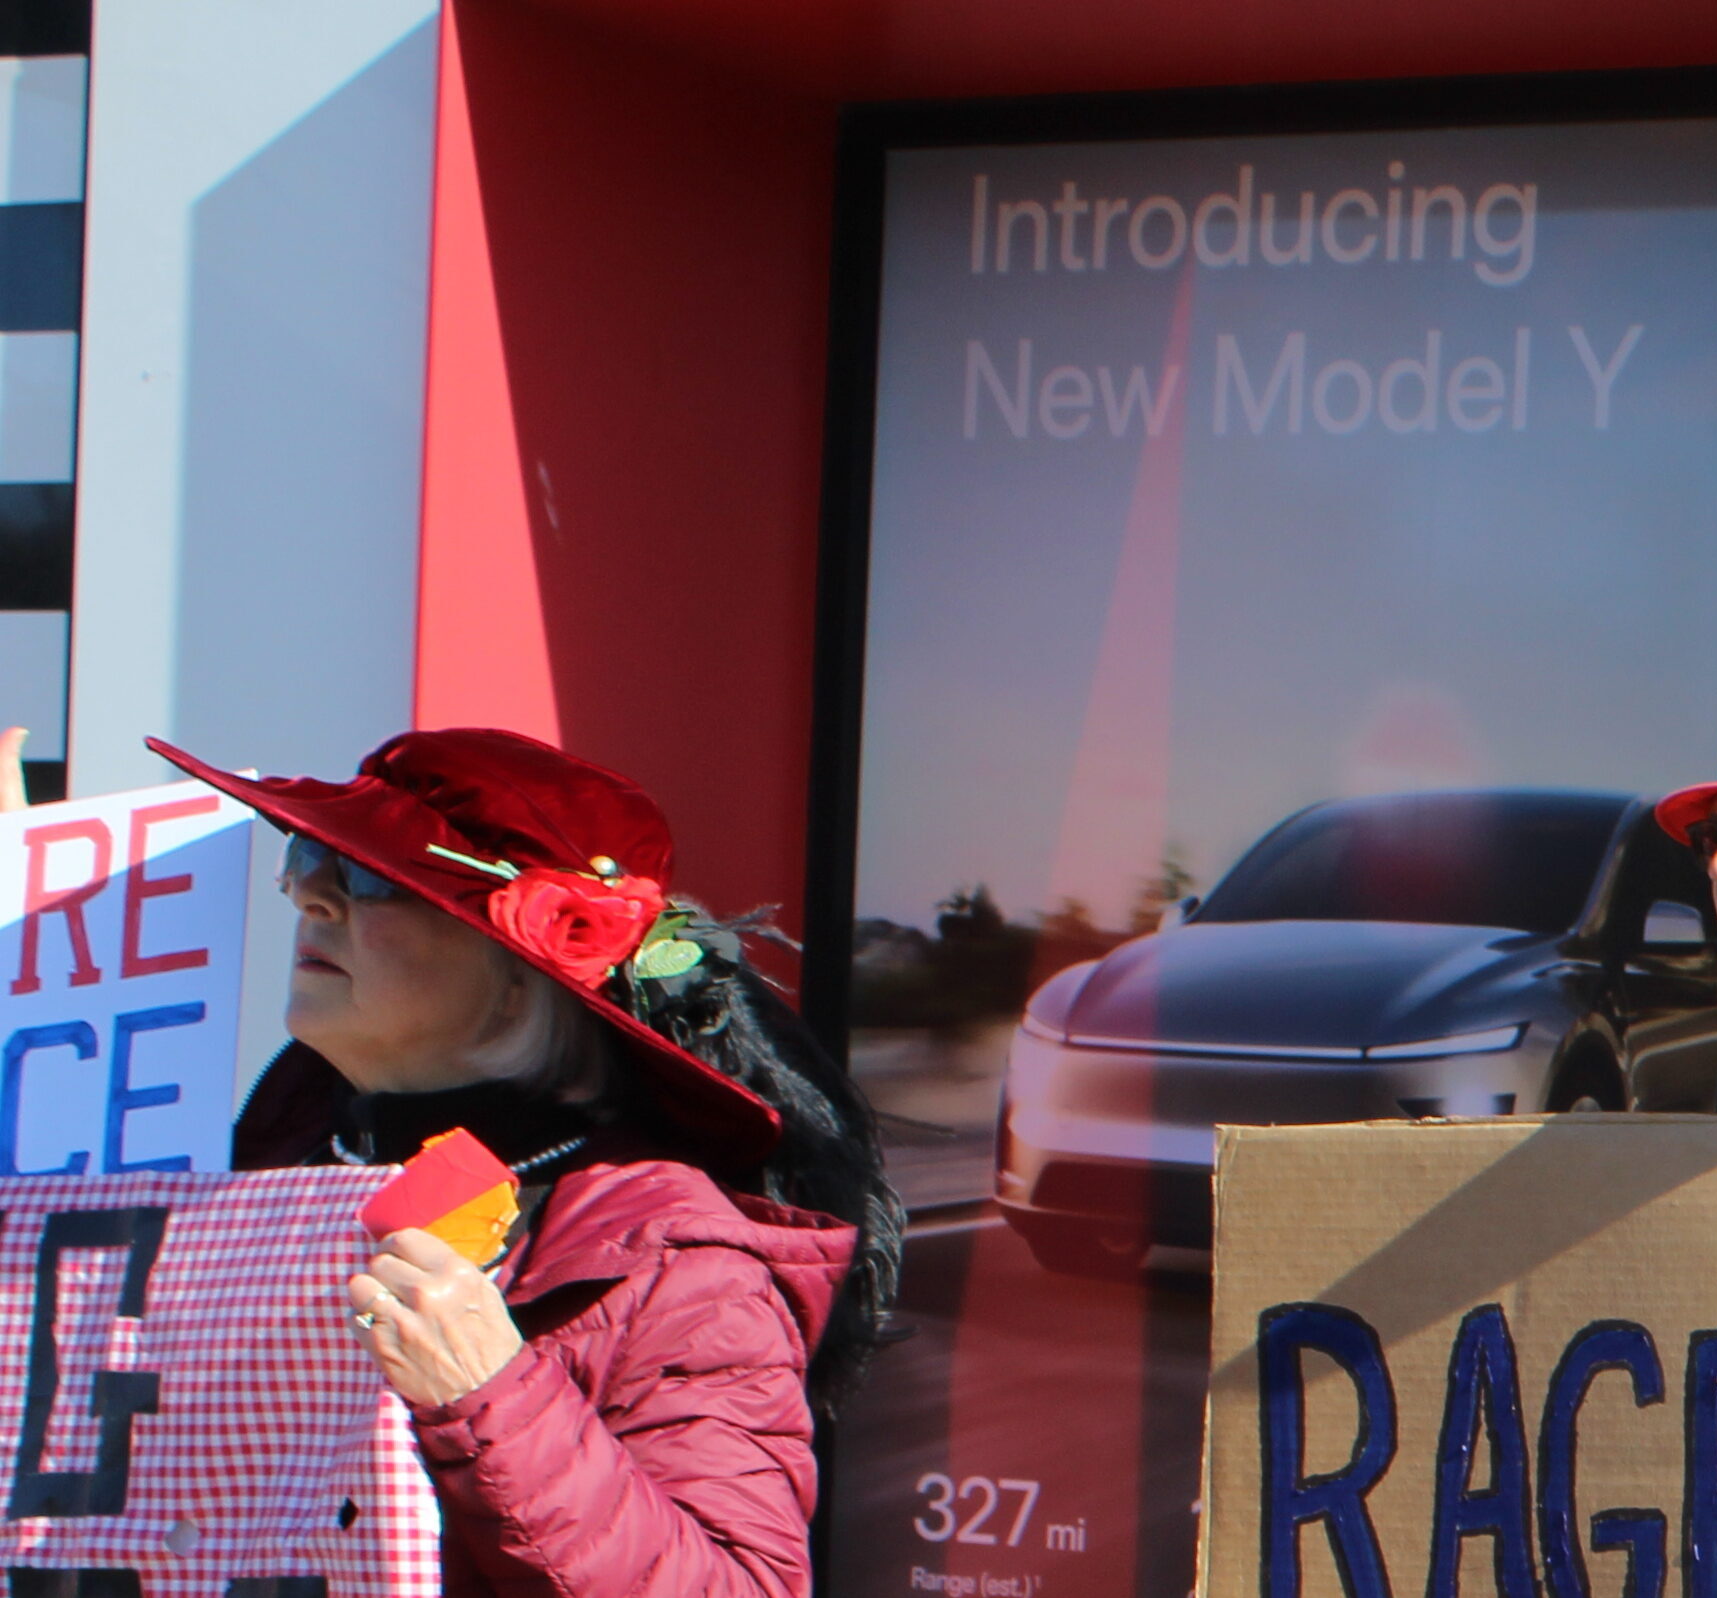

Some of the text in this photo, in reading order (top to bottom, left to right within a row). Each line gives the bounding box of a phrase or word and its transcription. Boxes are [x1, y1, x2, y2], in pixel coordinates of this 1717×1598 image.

[968, 160, 1538, 287] Introducing
[961, 325, 1645, 440] New Model Y
[10, 794, 222, 996] RE
[913, 1471, 1087, 1552] 327 mi
[911, 1565, 976, 1598] Range
